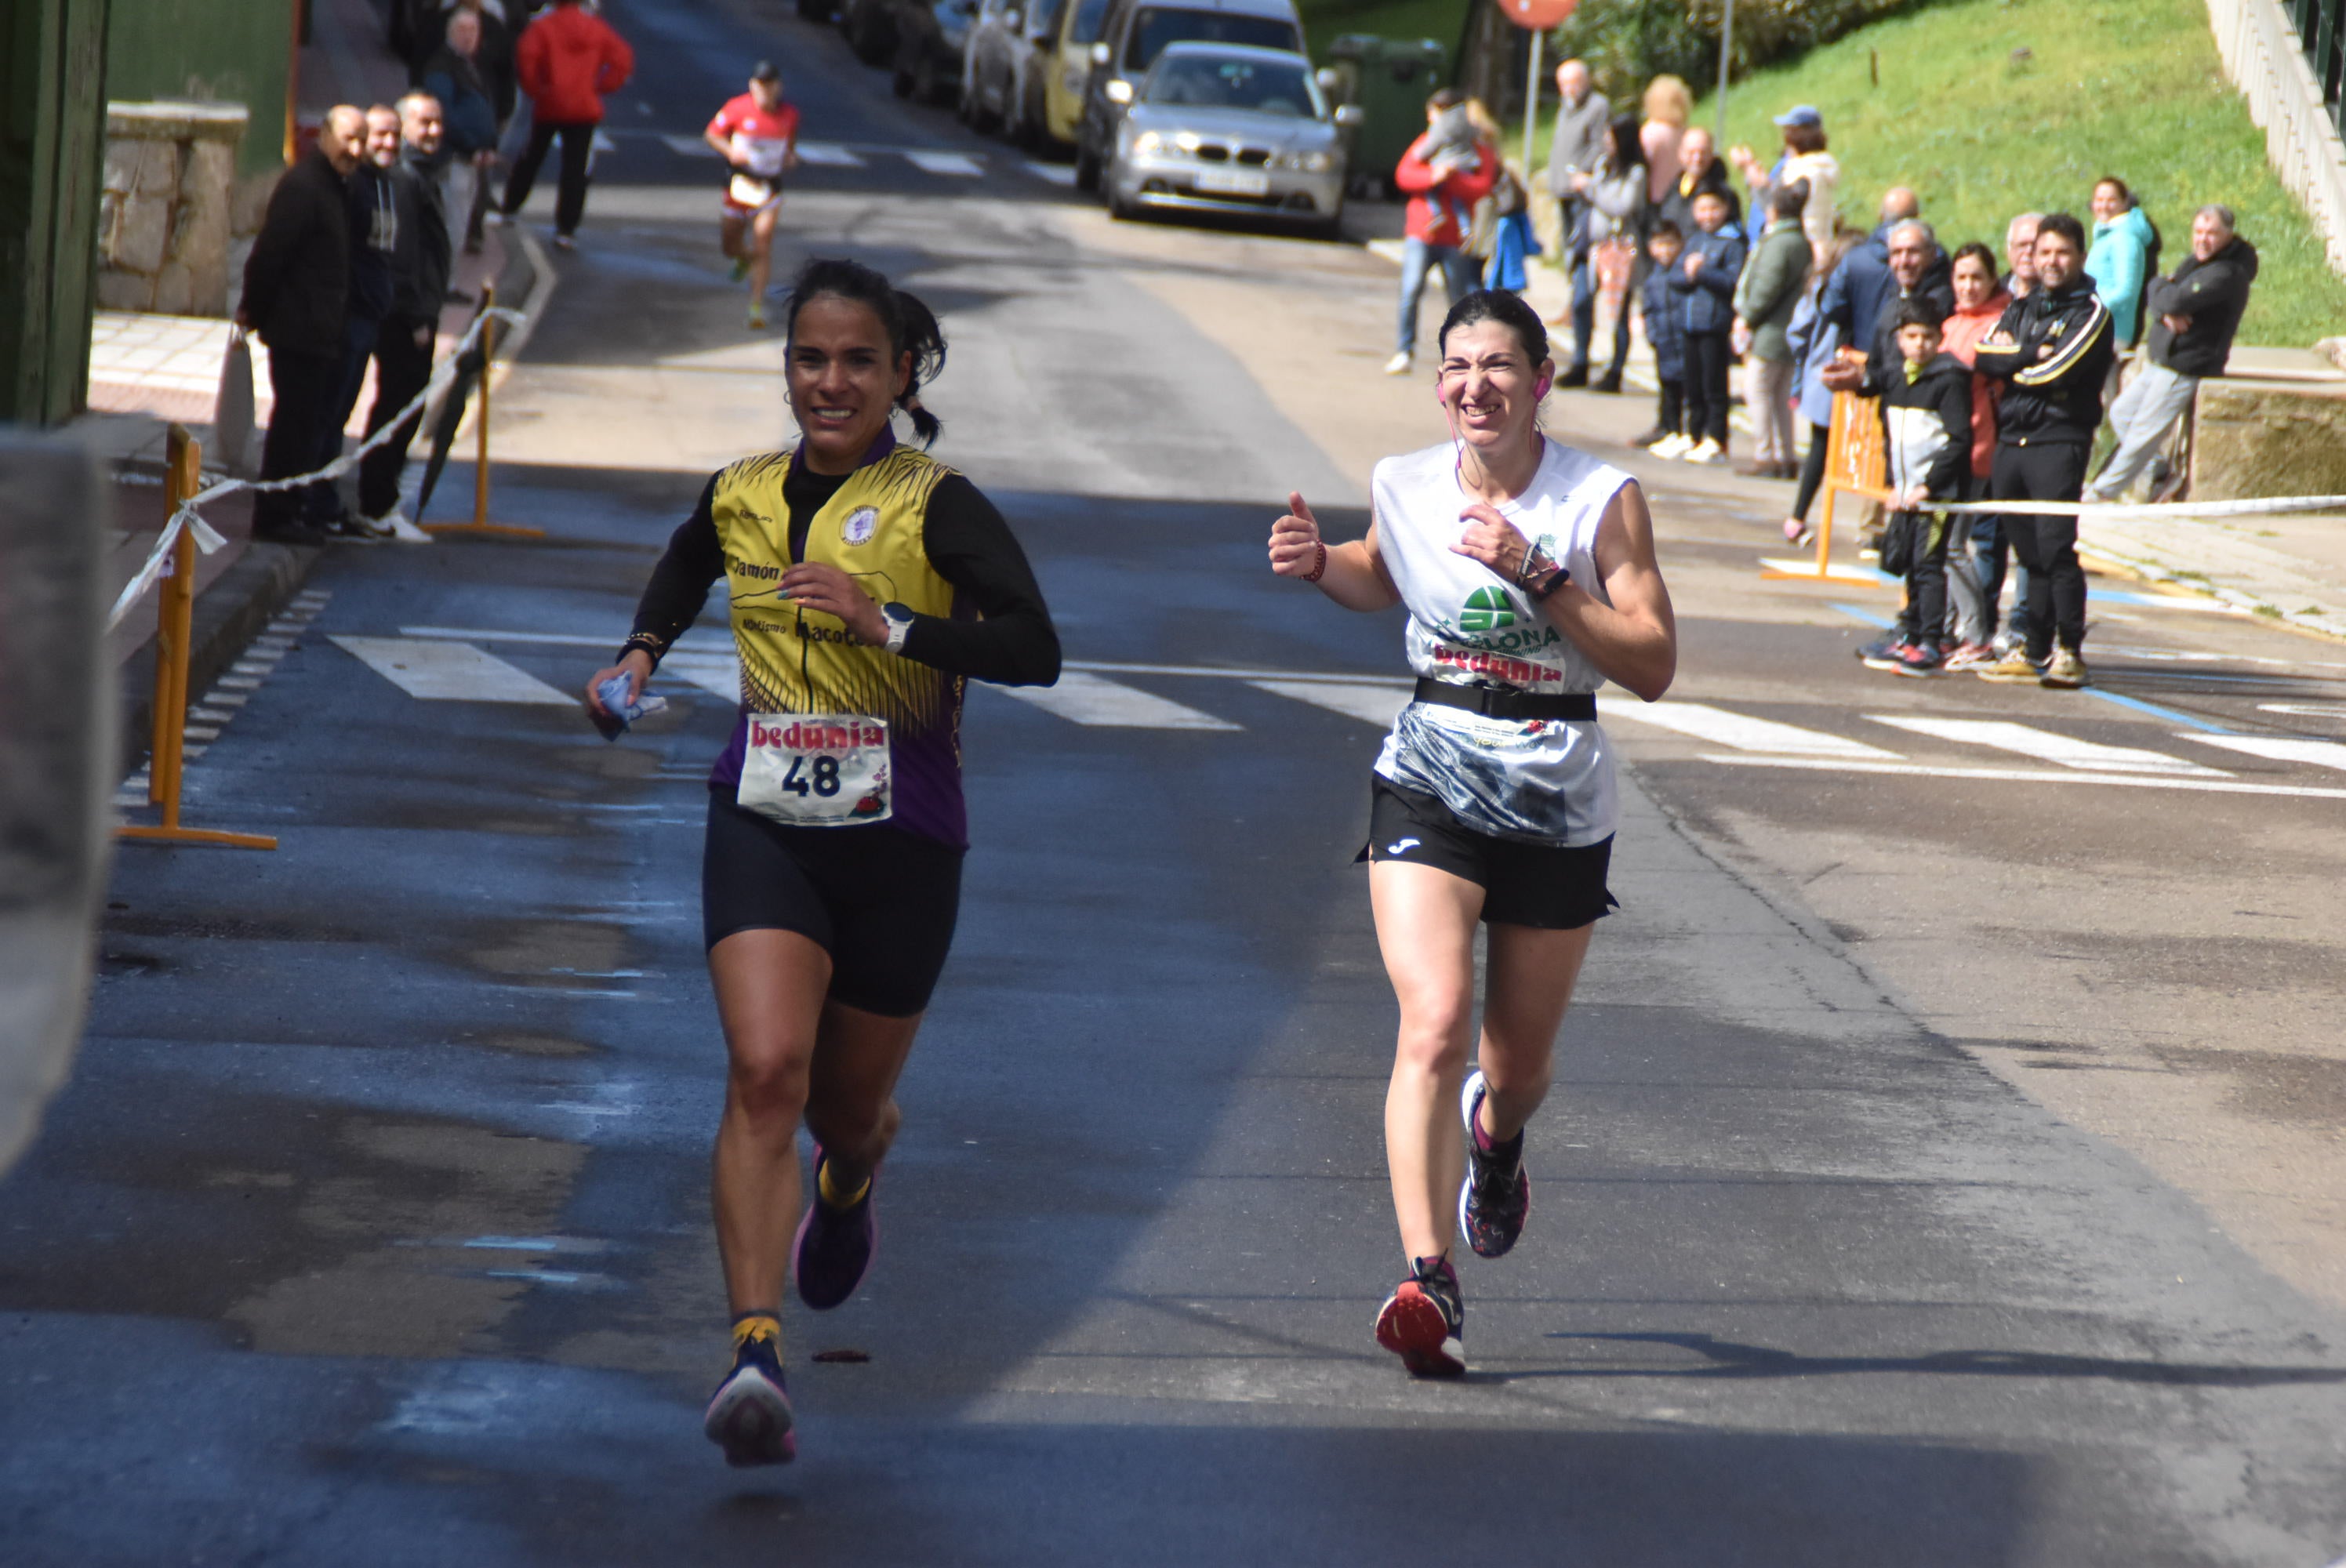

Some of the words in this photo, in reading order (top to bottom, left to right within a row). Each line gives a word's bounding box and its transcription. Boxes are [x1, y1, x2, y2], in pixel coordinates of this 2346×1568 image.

[1434, 643, 1563, 682] bedunia
[751, 720, 884, 750] bedunia
[782, 755, 841, 797] 48
